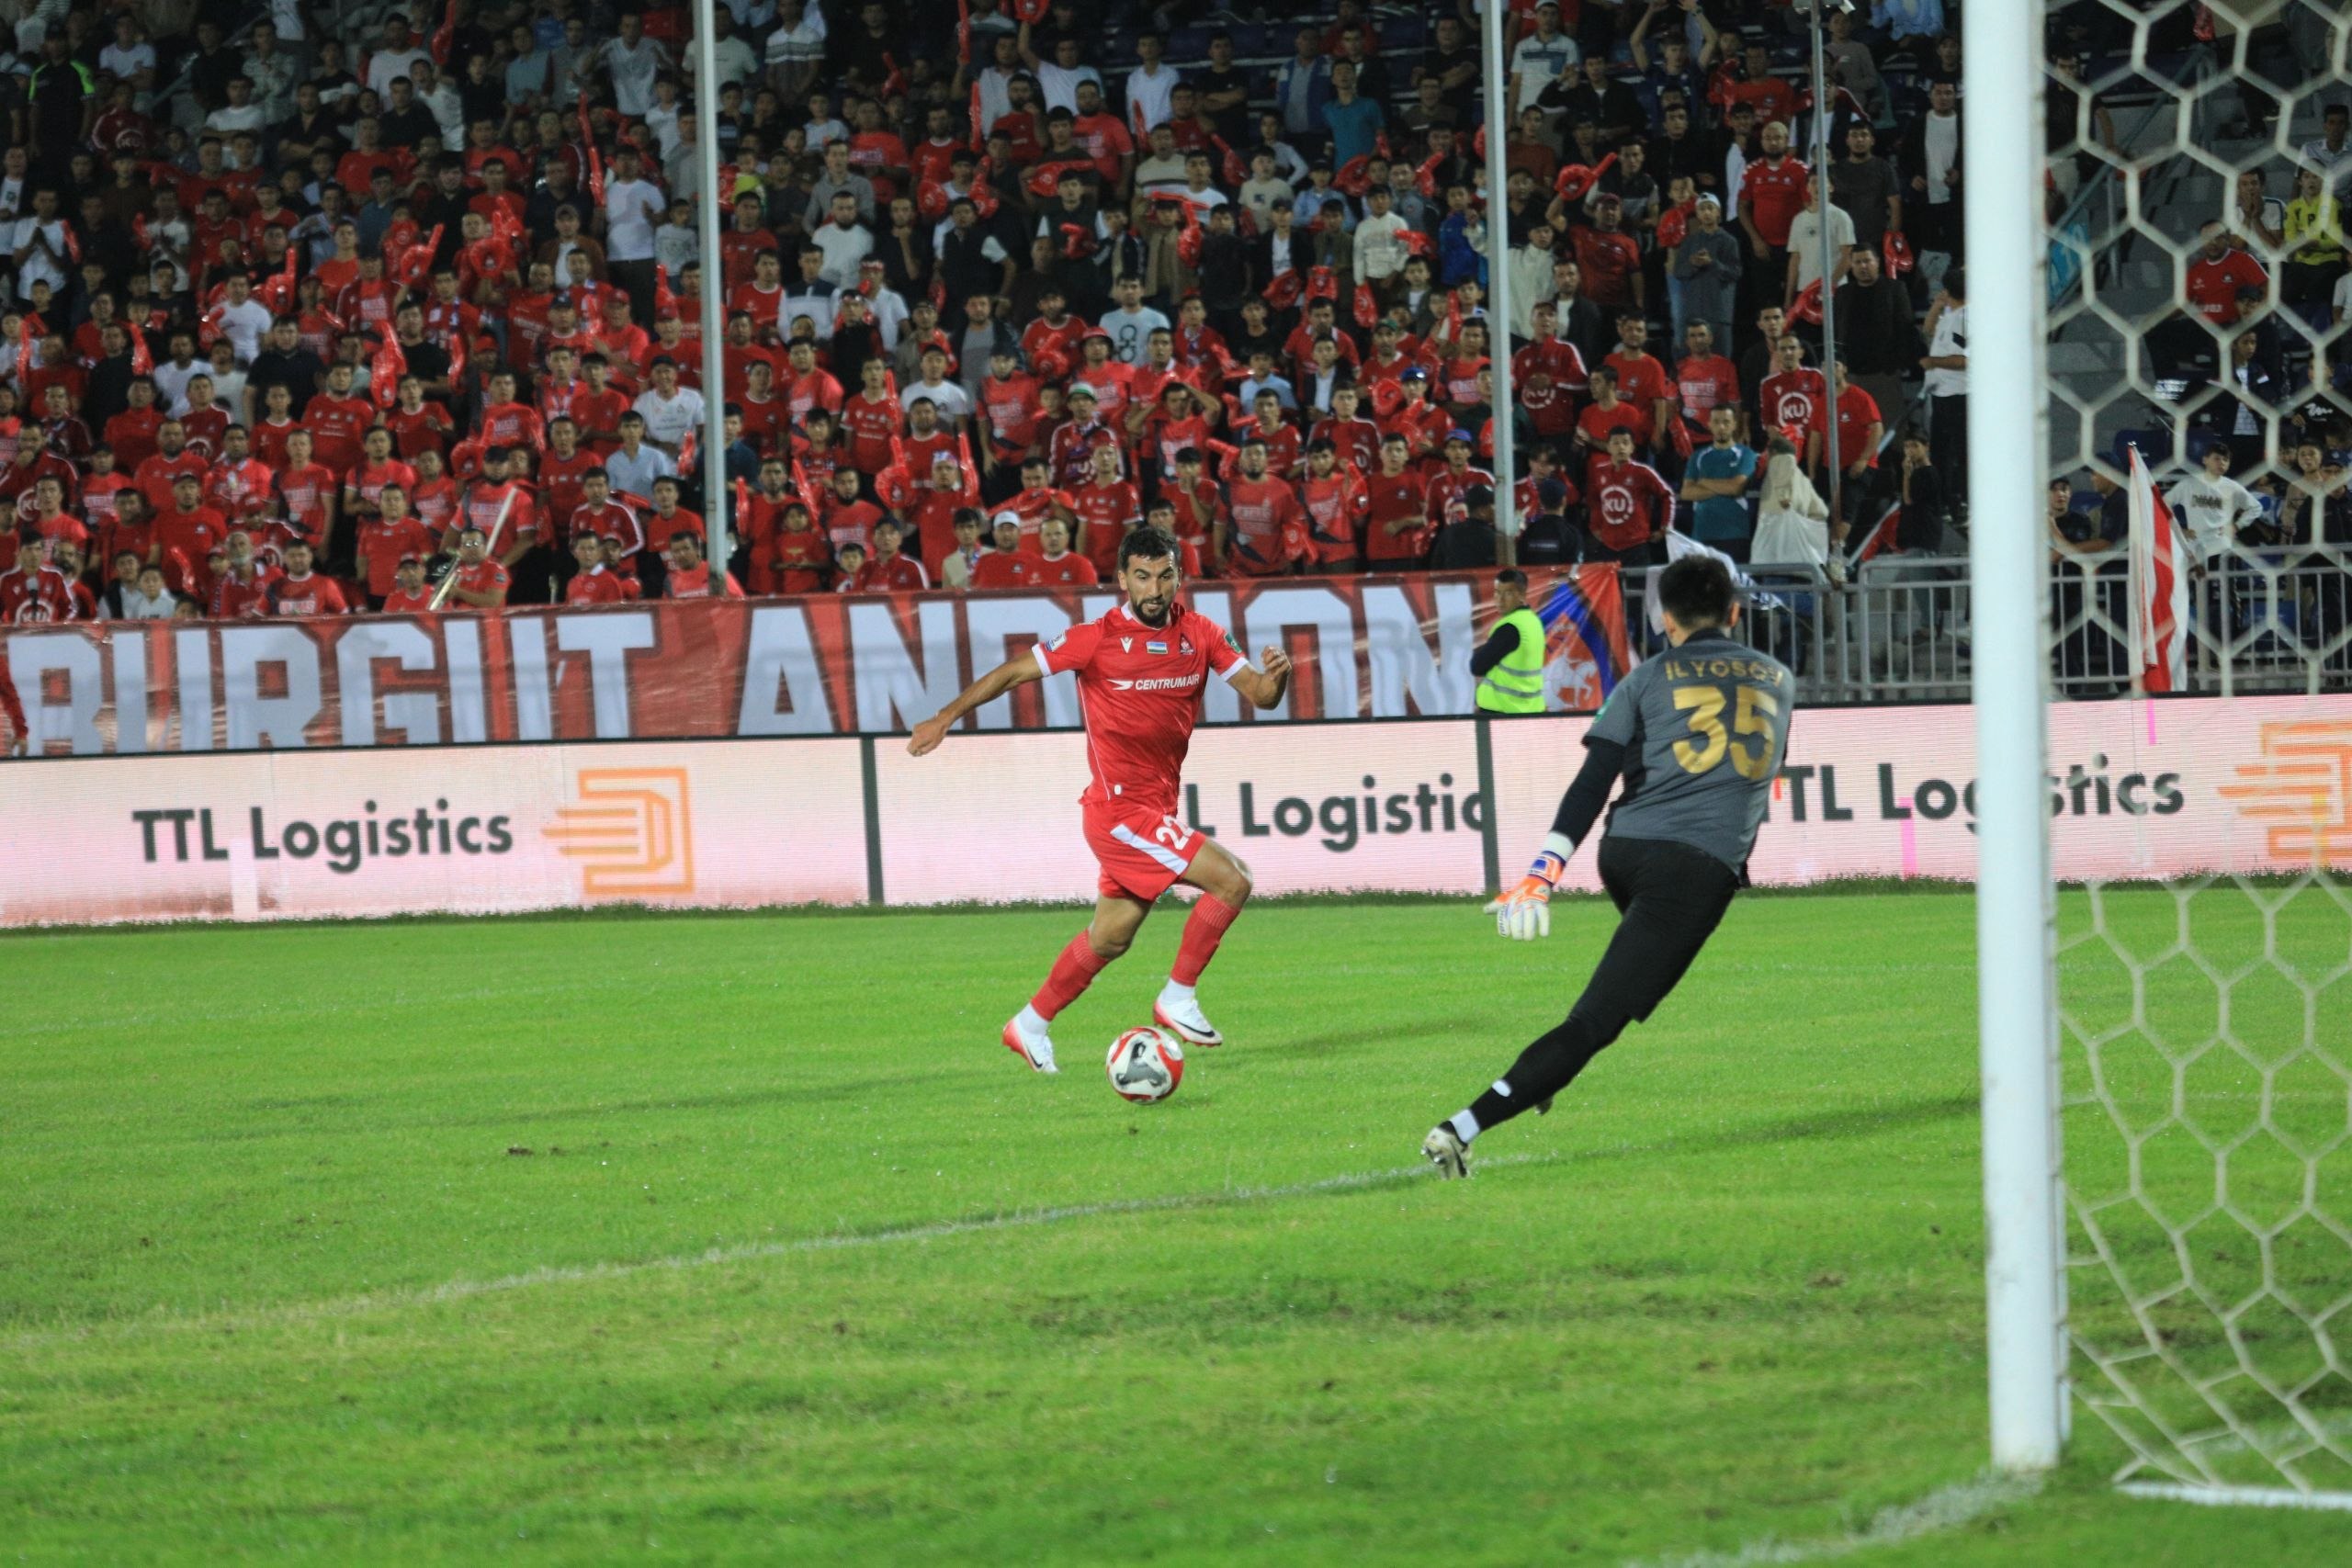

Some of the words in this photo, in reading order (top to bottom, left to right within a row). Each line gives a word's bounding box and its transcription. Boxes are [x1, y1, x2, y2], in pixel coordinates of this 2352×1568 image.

[1672, 684, 1778, 783] 35
[1762, 764, 1853, 823] TL
[1878, 752, 2185, 835] Lostics
[131, 807, 230, 863] TTL
[250, 797, 514, 874] Logistics
